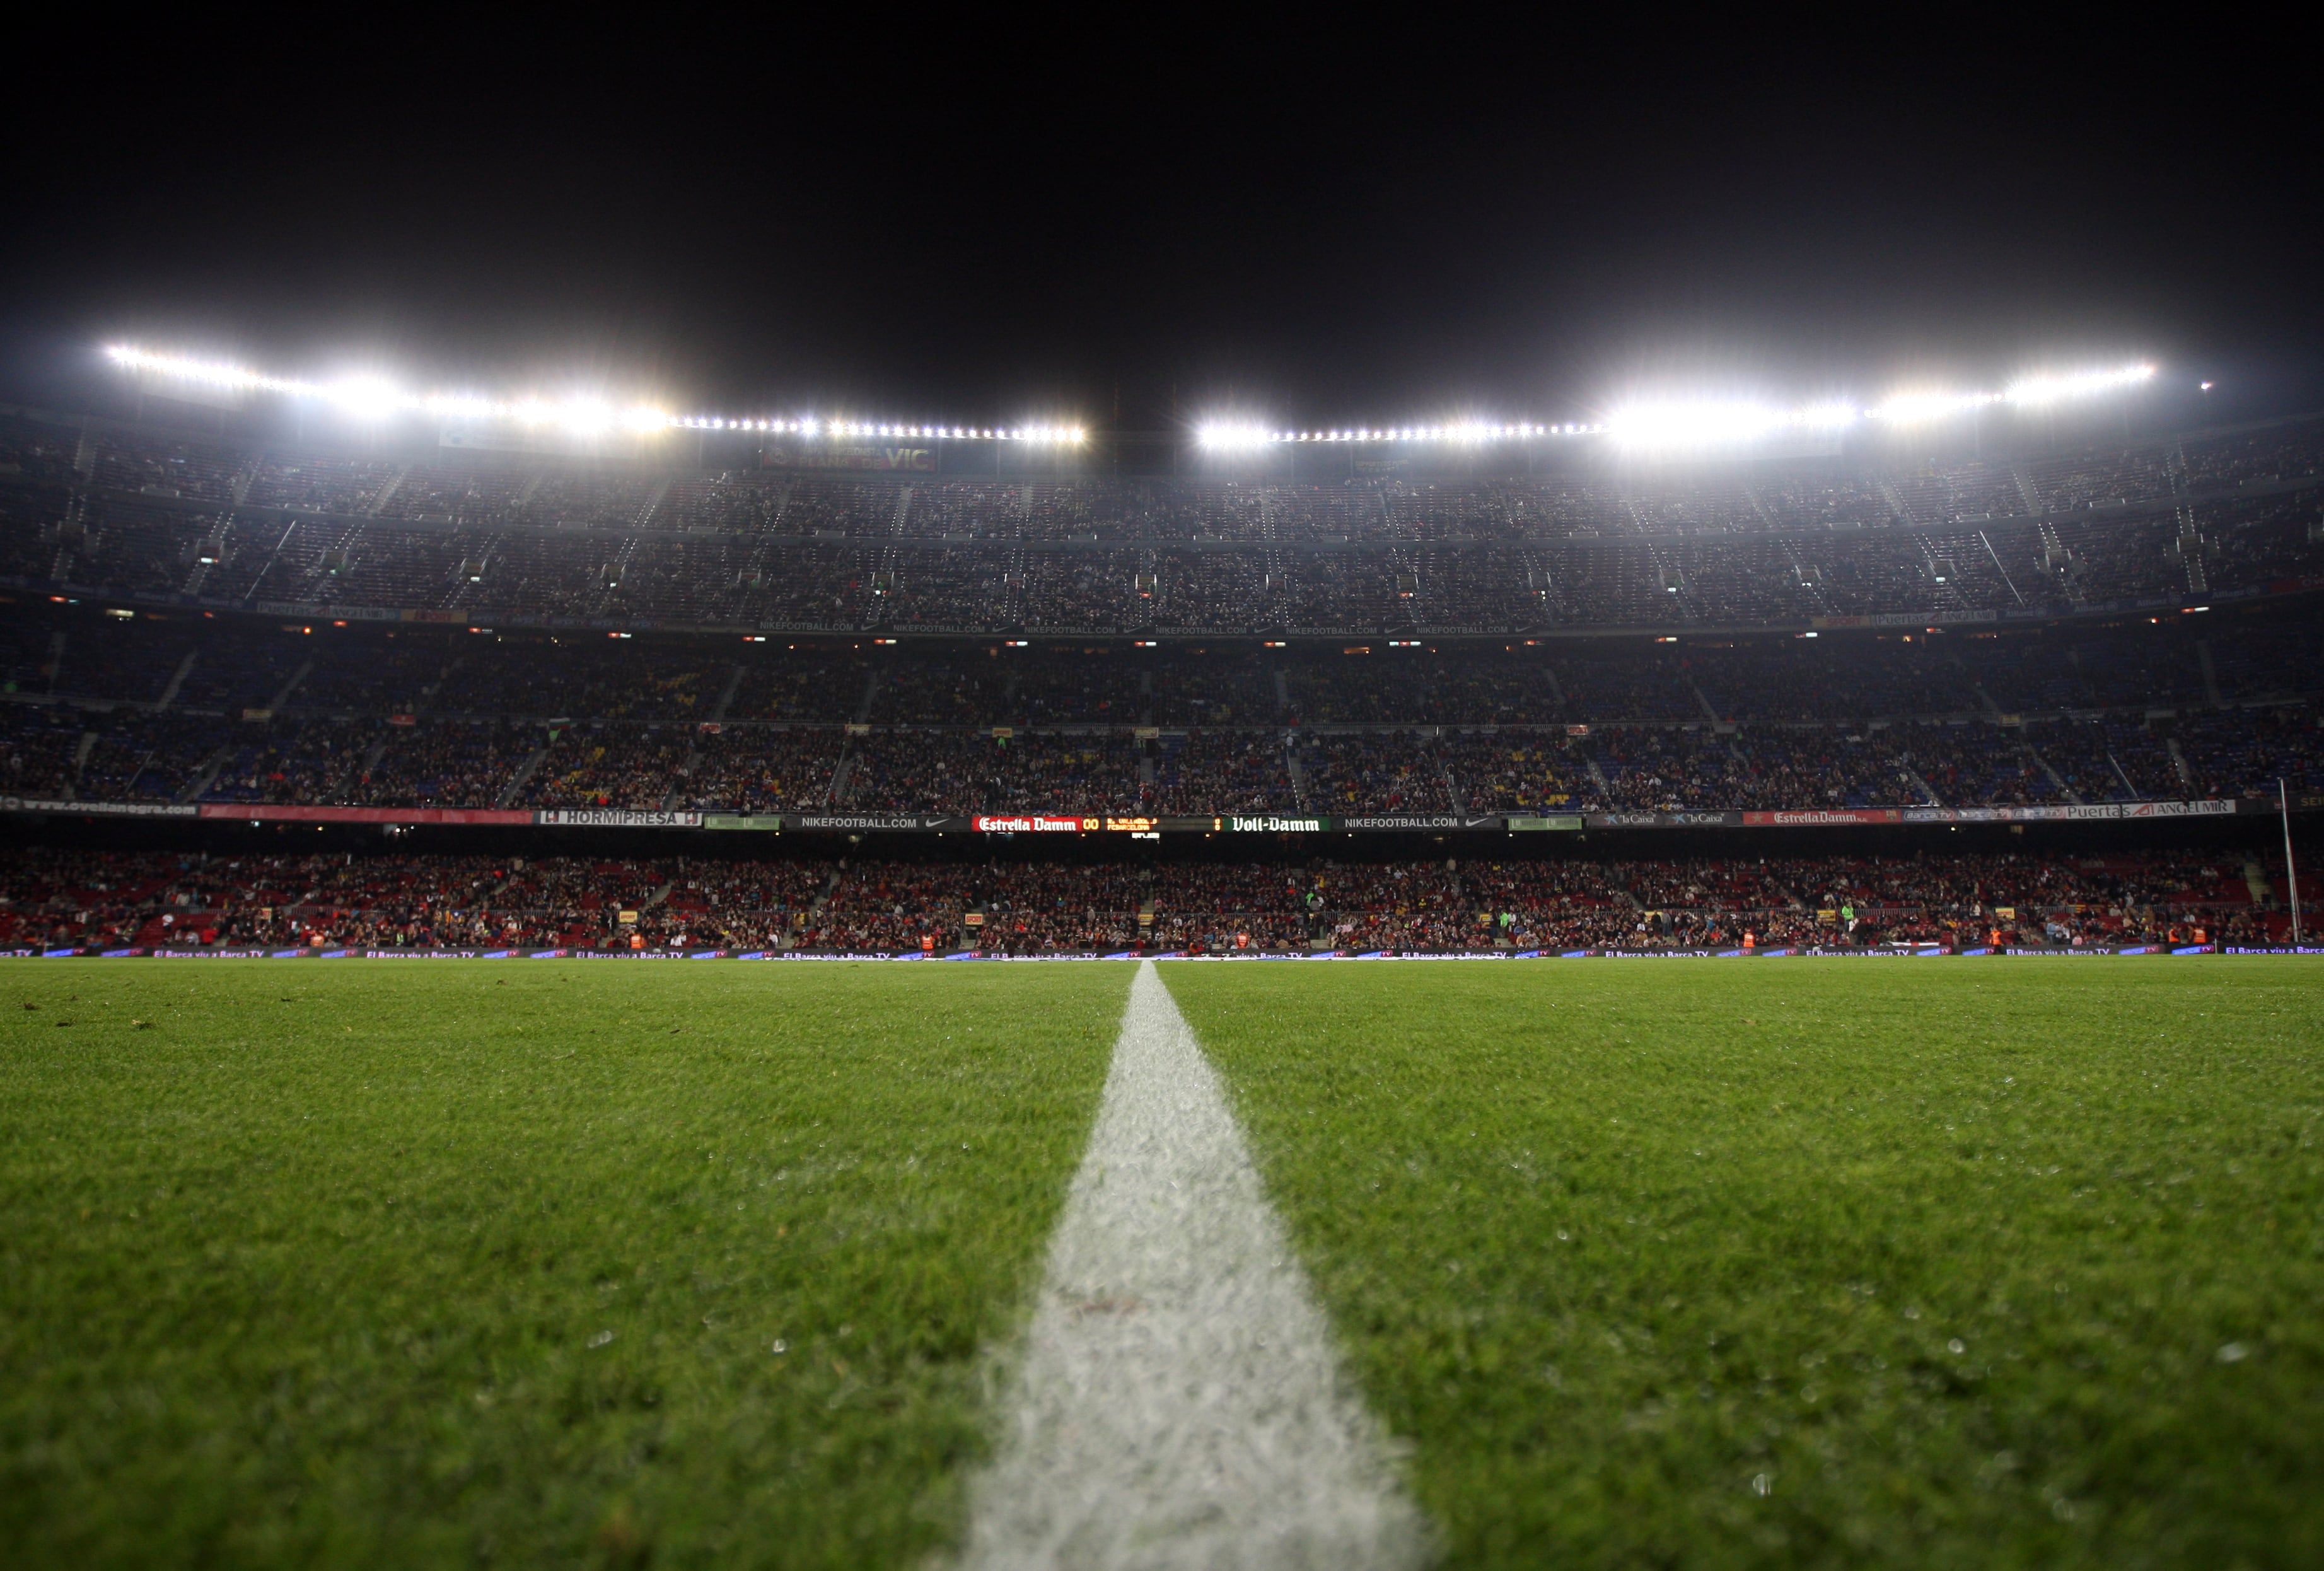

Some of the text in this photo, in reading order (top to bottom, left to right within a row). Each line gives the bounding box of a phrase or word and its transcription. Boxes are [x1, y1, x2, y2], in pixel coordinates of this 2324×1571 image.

[886, 448, 929, 469] VIC
[260, 603, 311, 615] Puertas
[1878, 614, 1925, 624] Puertas
[760, 622, 854, 631] NIKEFOOTBALL.COM
[893, 624, 985, 633] NIKEFOOTBALL.COM
[1025, 626, 1116, 634] NIKEFOOTBALL.COM
[1156, 626, 1246, 634] NIKEFOOTBALL.COM
[2067, 805, 2131, 818] Puertas
[2202, 800, 2228, 812] MIR
[567, 810, 677, 824] HORMIPRESA
[802, 817, 916, 828] NIKEFOOTBALL.COM
[1345, 818, 1457, 827] NIKEFOOTBALL.COM
[1774, 812, 1818, 823] Estrella
[1819, 811, 1857, 822] Damm
[979, 817, 1076, 831] Estrella Damm
[1083, 818, 1100, 830] 00
[1232, 817, 1319, 831] Voll-Damm
